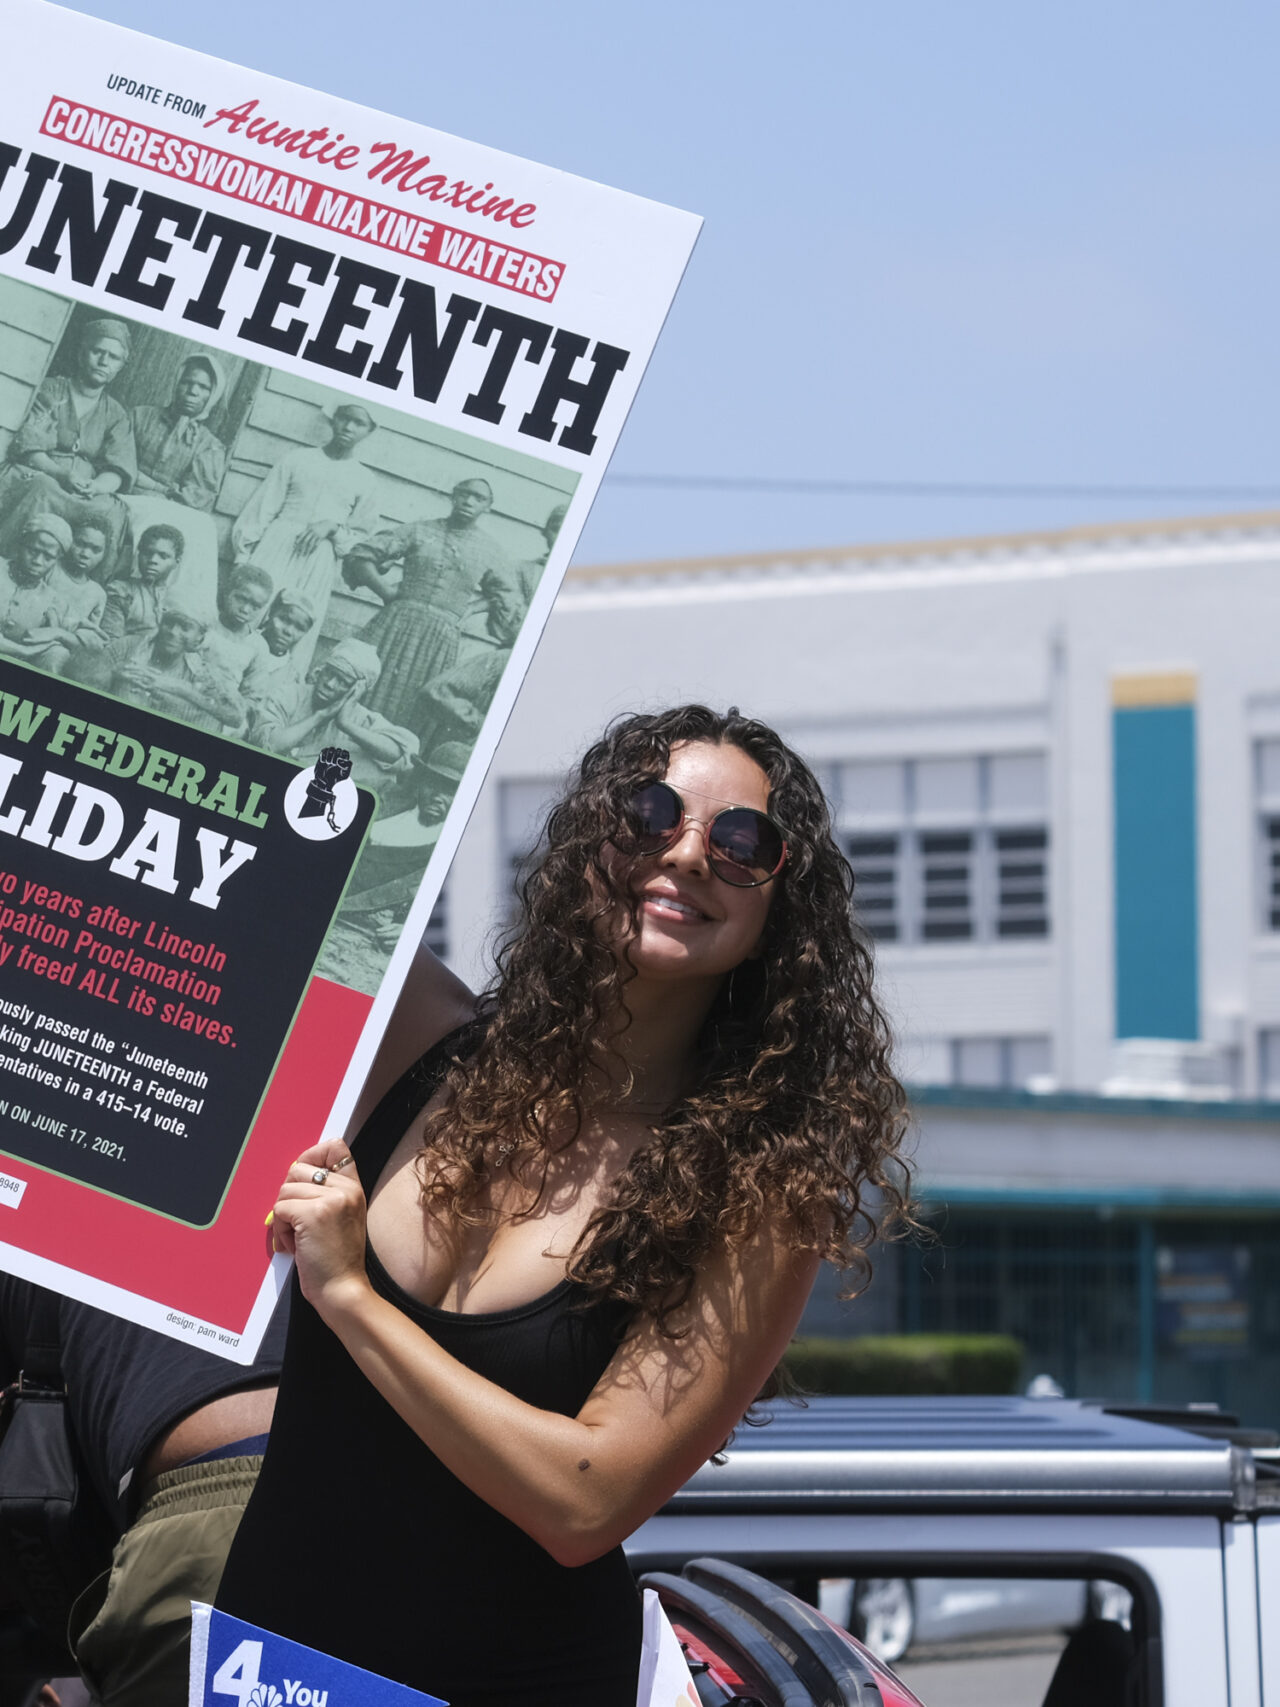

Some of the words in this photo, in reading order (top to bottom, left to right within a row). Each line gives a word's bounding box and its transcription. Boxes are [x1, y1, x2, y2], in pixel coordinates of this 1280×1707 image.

[107, 74, 162, 104] UPDATE
[163, 92, 206, 119] FROM
[205, 99, 360, 170] Auntie
[367, 141, 536, 228] Maxine
[45, 101, 312, 215] CONGRESSWOMAN
[313, 190, 434, 256] MAXINE
[438, 230, 560, 297] WATERS
[46, 712, 268, 828] FEDERAL
[19, 881, 83, 918] years
[86, 905, 141, 939] after
[143, 921, 226, 972] Lincoln
[16, 944, 77, 986] freed
[77, 968, 119, 1004] ALL
[127, 985, 156, 1016] its
[160, 1002, 236, 1047] slaves.
[73, 930, 221, 1005] Proclamation
[34, 1014, 90, 1043] passed
[91, 1032, 115, 1053] the
[32, 1038, 131, 1087] JUNETEENTH
[132, 1078, 143, 1092] a
[145, 1080, 204, 1114] Federal
[64, 1077, 80, 1095] in
[82, 1087, 93, 1100] a
[154, 1114, 187, 1138] vote.
[10, 1105, 31, 1123] ON
[31, 1114, 67, 1138] JUNE
[70, 1128, 86, 1148] 17,
[91, 1137, 125, 1161] 2021.
[196, 1325, 216, 1338] pam
[218, 1334, 239, 1347] ward
[212, 1639, 264, 1707] 4
[283, 1678, 329, 1707] You
